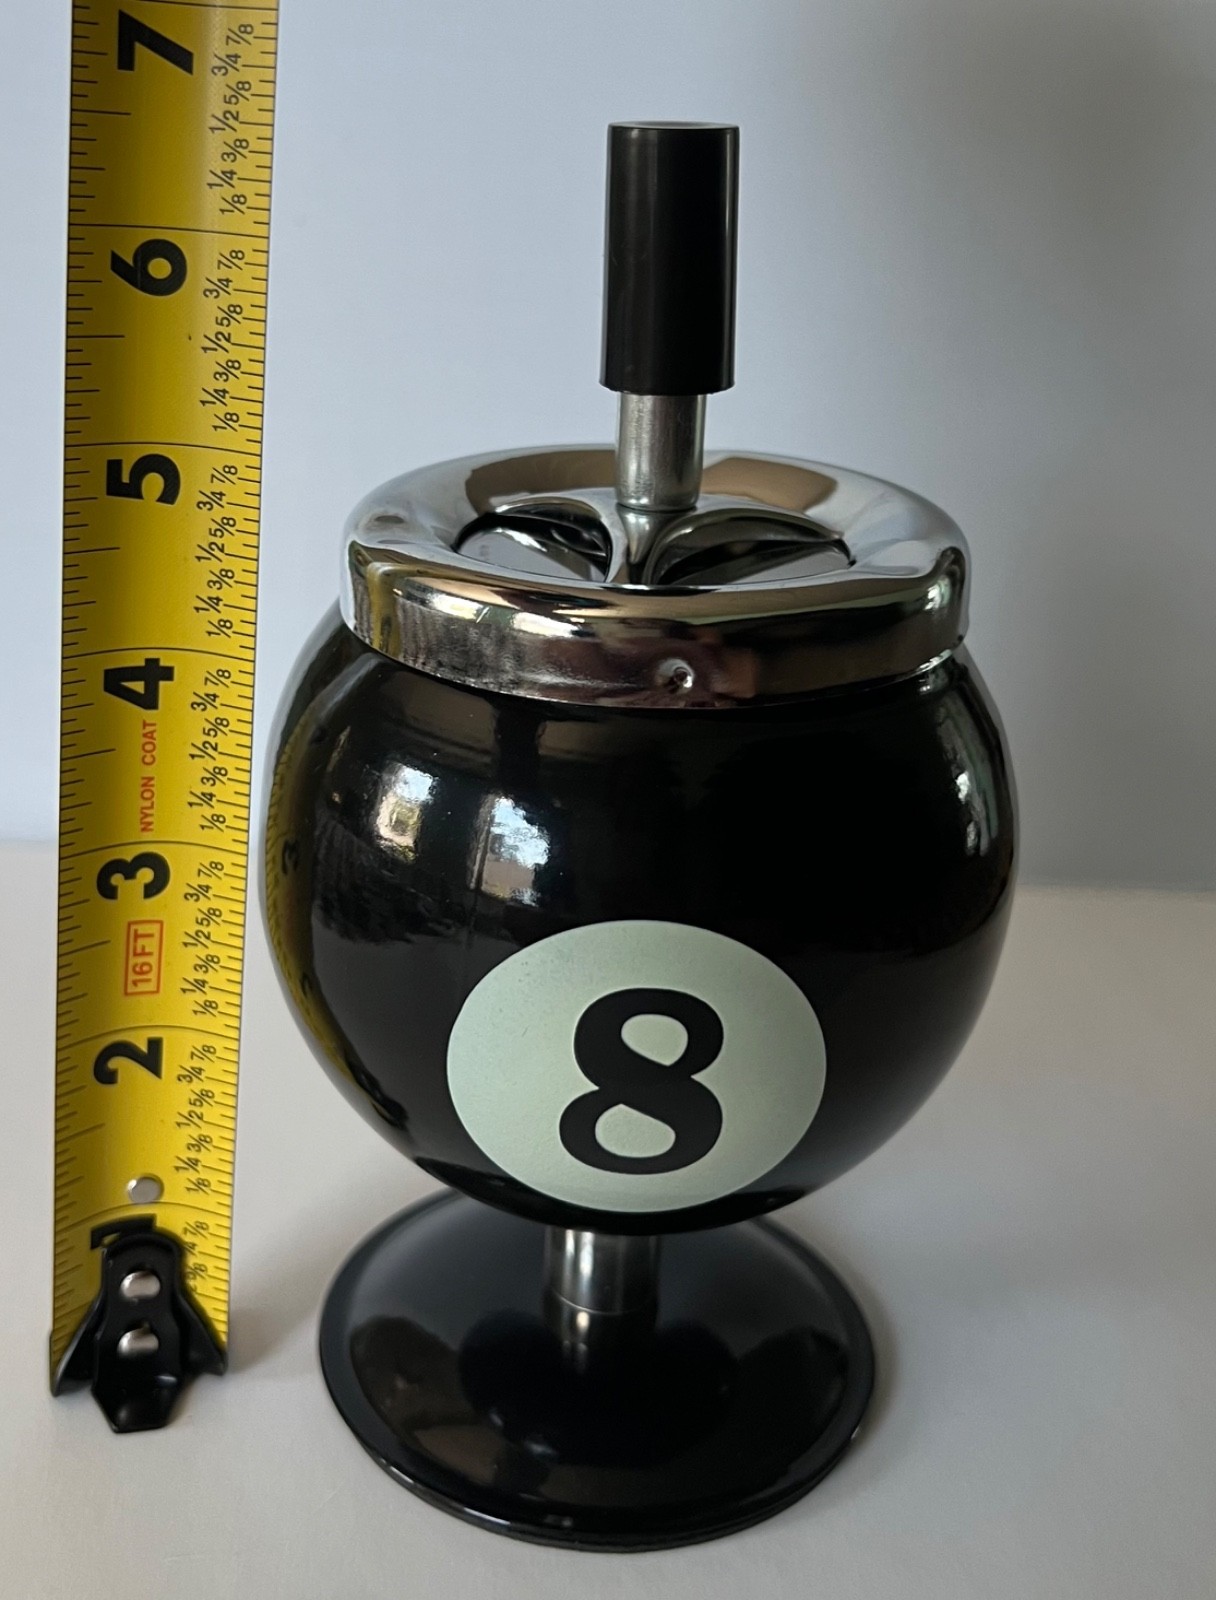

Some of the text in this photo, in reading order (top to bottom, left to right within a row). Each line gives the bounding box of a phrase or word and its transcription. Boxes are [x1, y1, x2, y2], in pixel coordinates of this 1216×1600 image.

[118, 9, 193, 75] 7
[225, 24, 254, 45] 7/8
[211, 53, 241, 76] 3/4
[224, 80, 252, 105] 5/8
[209, 110, 239, 133] 1/2
[221, 138, 249, 162] 3/8
[206, 169, 237, 189] 1/4
[219, 194, 247, 215] 1/8
[110, 239, 187, 296] 6
[217, 250, 245, 270] 7/8
[203, 277, 233, 299] 3/4
[216, 304, 243, 327] 5/8
[201, 331, 231, 353] 1/2
[213, 359, 241, 382] 3/8
[200, 388, 229, 406] 1/4
[212, 412, 239, 432] 1/8
[106, 453, 181, 505] 5
[211, 465, 238, 485] 7/8
[196, 490, 226, 510] 3/4
[209, 517, 236, 538] 5/8
[195, 543, 224, 562] 1/2
[207, 569, 235, 590] 3/8
[193, 595, 223, 613] 1/4
[206, 619, 233, 638] 1/8
[104, 658, 174, 710] 4
[204, 669, 231, 688] 7/8
[190, 692, 219, 711] 3/4
[203, 717, 229, 738] 5/8
[189, 742, 218, 761] 1/2
[140, 720, 157, 832] NYLON COAT
[201, 766, 228, 786] 3/8
[187, 790, 216, 808] 1/4
[200, 814, 226, 832] 1/8
[97, 852, 170, 900] 3
[197, 861, 224, 880] 7/8
[184, 883, 212, 902] 3/4
[196, 908, 222, 927] 5/8
[182, 931, 211, 949] 1/2
[194, 954, 220, 974] 3/8
[180, 977, 208, 995] 1/4
[192, 1000, 219, 1017] 1/8
[94, 1037, 163, 1085] 2
[190, 1045, 216, 1063] 7/8
[177, 1065, 204, 1084] 3/4
[559, 987, 724, 1175] 8
[189, 1089, 215, 1107] 5/8
[176, 1111, 203, 1129] 1/2
[187, 1134, 213, 1151] 3/8
[174, 1156, 201, 1173] 1/4
[185, 1178, 211, 1195] 1/8
